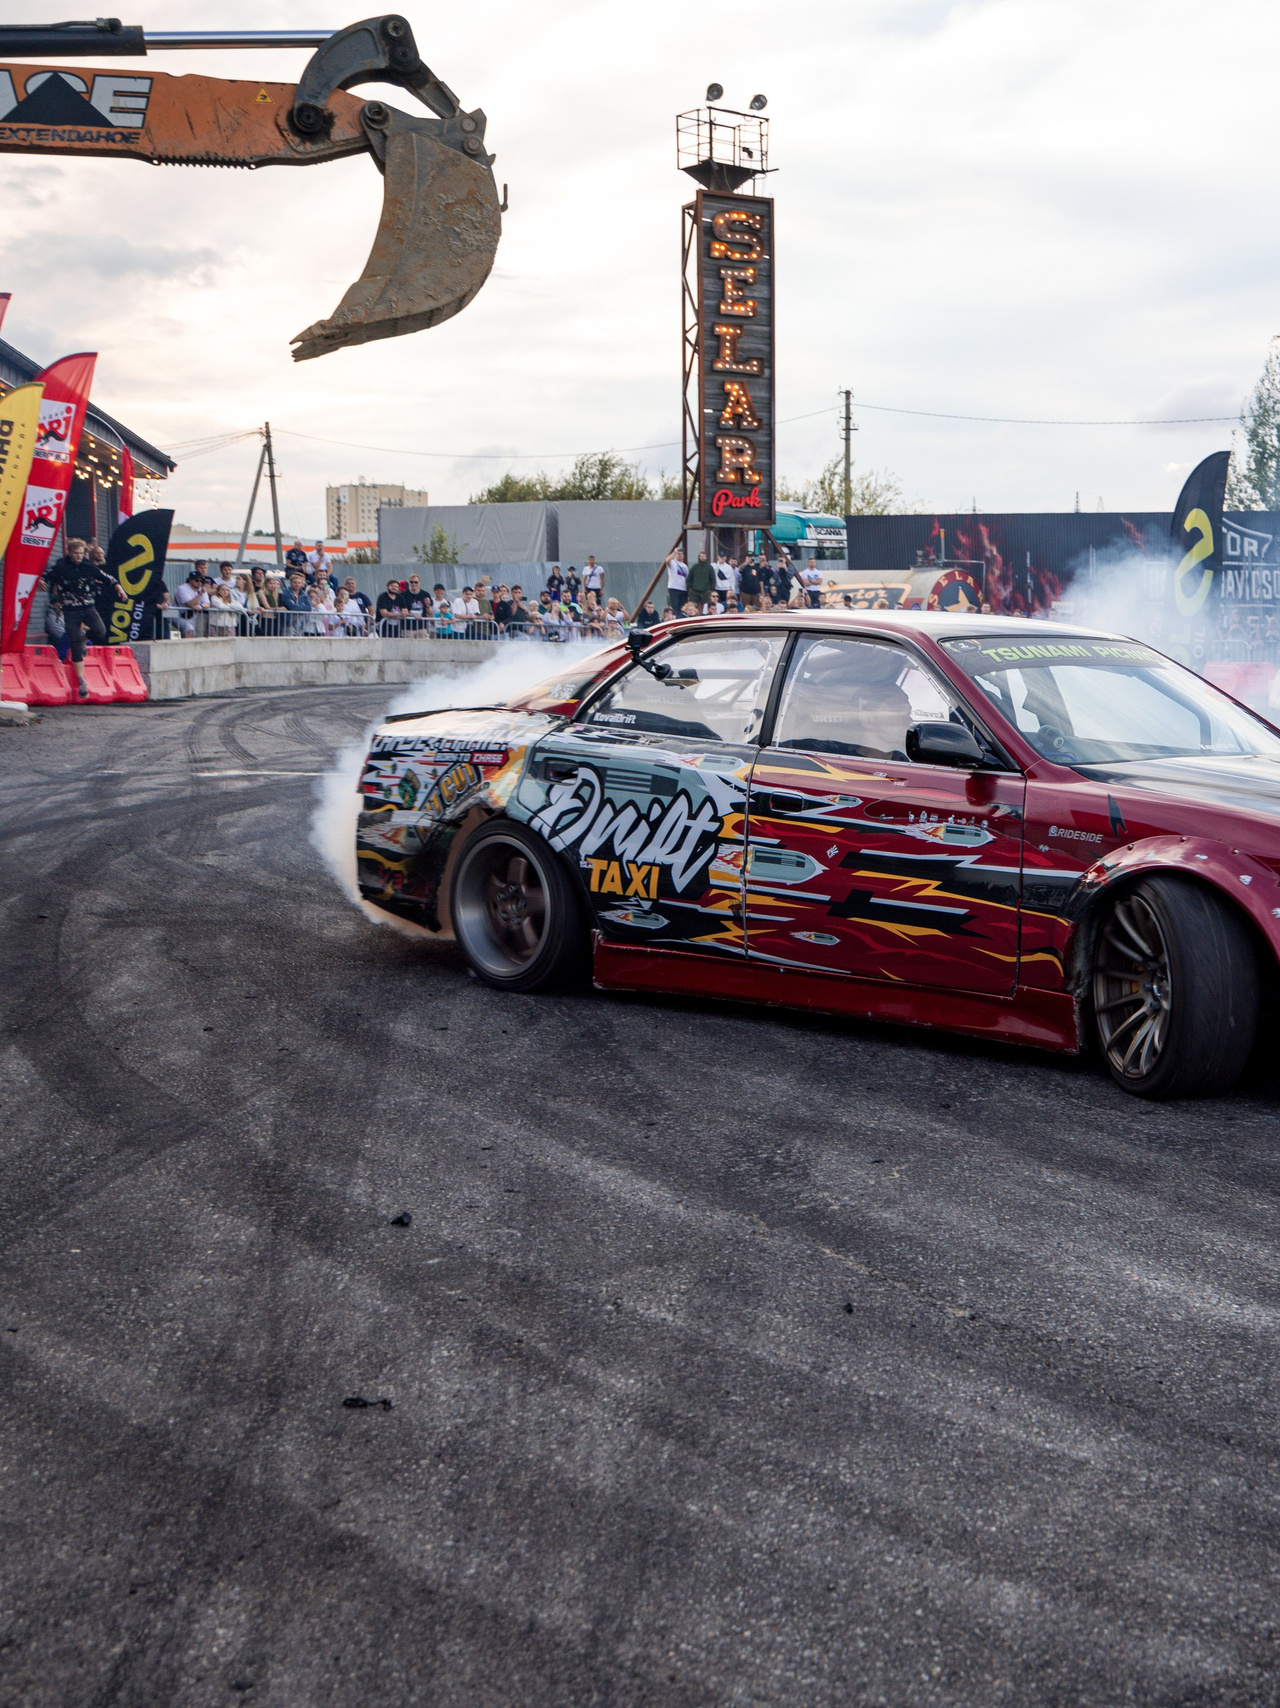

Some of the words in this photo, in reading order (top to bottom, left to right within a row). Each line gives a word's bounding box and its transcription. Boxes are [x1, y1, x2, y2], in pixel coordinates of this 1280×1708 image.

[710, 208, 765, 485] SELAR
[711, 487, 763, 516] Park
[815, 527, 843, 537] SCANIA
[108, 599, 134, 643] VOL
[133, 601, 145, 620] OIL
[982, 645, 1092, 663] TSUNAMI
[1090, 645, 1161, 663] PICNIC
[593, 712, 637, 724] KovalDrift
[473, 753, 504, 763] CHASE
[529, 766, 720, 893] Drift
[587, 857, 660, 899] TAXI
